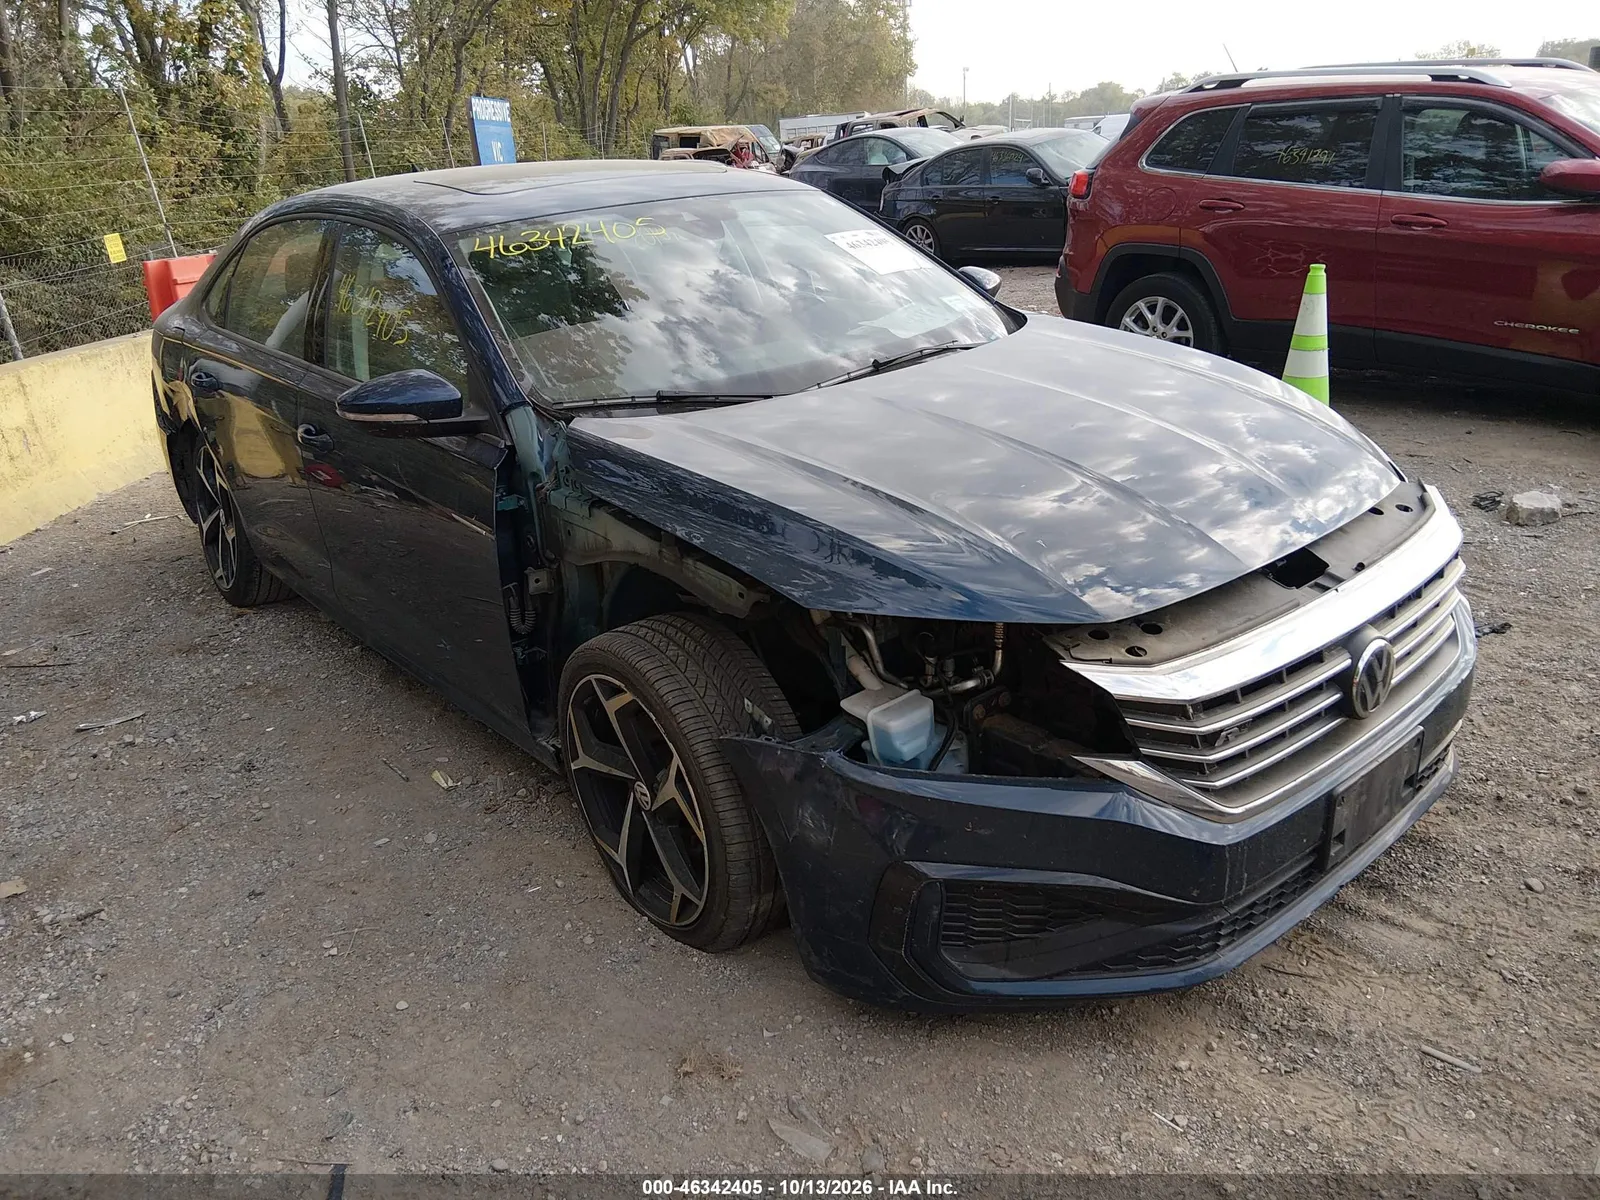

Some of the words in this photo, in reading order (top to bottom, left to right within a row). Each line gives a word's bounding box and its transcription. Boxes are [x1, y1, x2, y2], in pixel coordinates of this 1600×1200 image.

[473, 217, 666, 259] 46342405
[337, 274, 412, 346] 46342405
[1493, 320, 1580, 335] CHEROKEE
